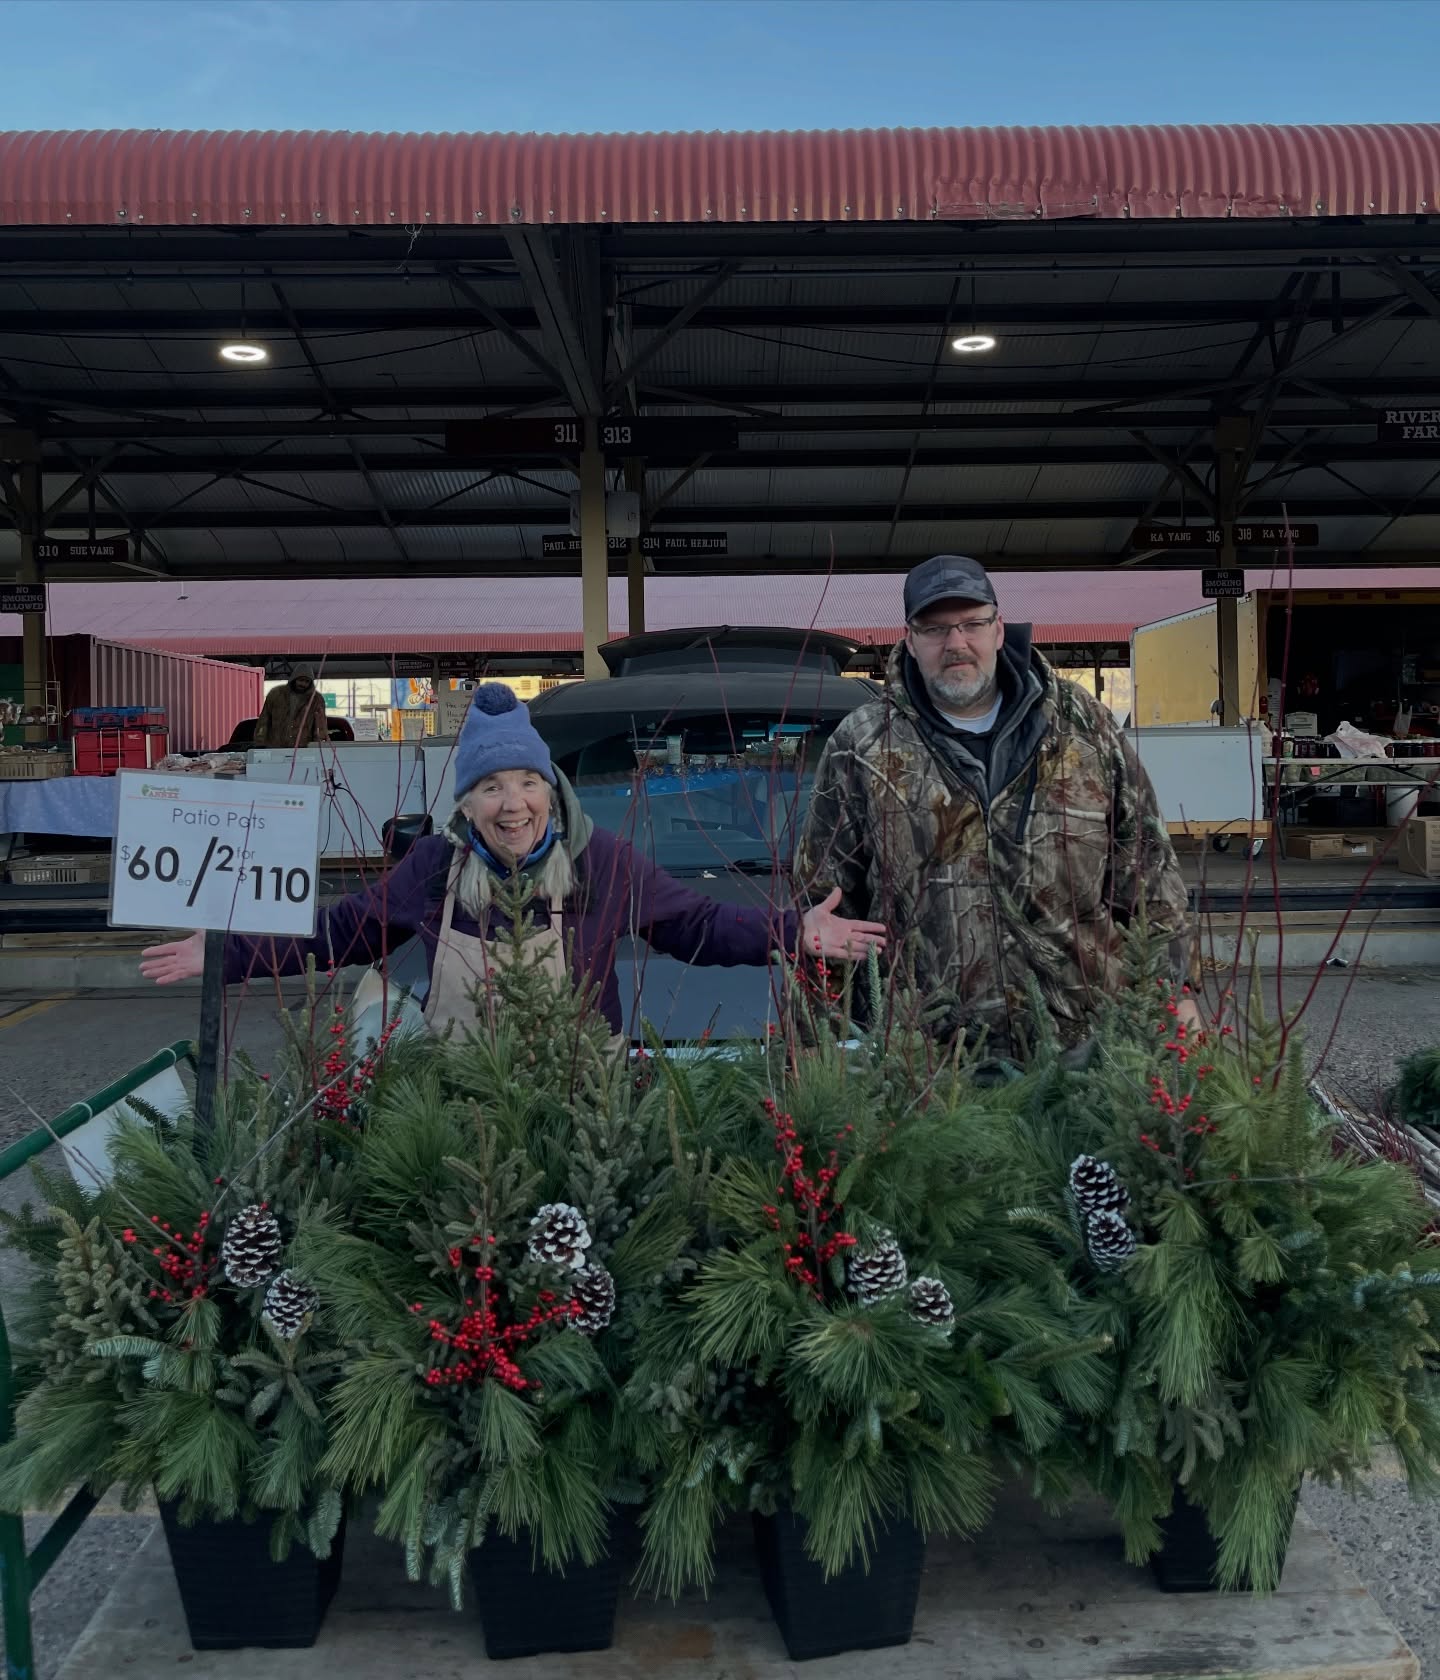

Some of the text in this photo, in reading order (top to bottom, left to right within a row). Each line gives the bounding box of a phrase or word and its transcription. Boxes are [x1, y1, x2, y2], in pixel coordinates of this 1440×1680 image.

[1385, 410, 1440, 424] RIVER
[554, 424, 578, 442] 311
[603, 426, 632, 443] 313
[1150, 530, 1221, 543] KA YANG 316
[1238, 528, 1252, 541] 318
[1262, 529, 1275, 539] KA
[543, 542, 566, 551] PAUL
[608, 537, 627, 549] 312
[643, 537, 660, 549] 314
[665, 539, 687, 548] PAUL
[38, 545, 115, 557] 310 SUE VANG
[1217, 571, 1229, 579] NO
[1205, 579, 1242, 587] SMOKING
[15, 586, 29, 594] NO
[1205, 587, 1242, 595] ALLOWED
[2, 594, 43, 602] SMOKING
[1, 602, 44, 611] ALLOWED
[172, 807, 266, 830] Patio Pots
[236, 846, 256, 860] for
